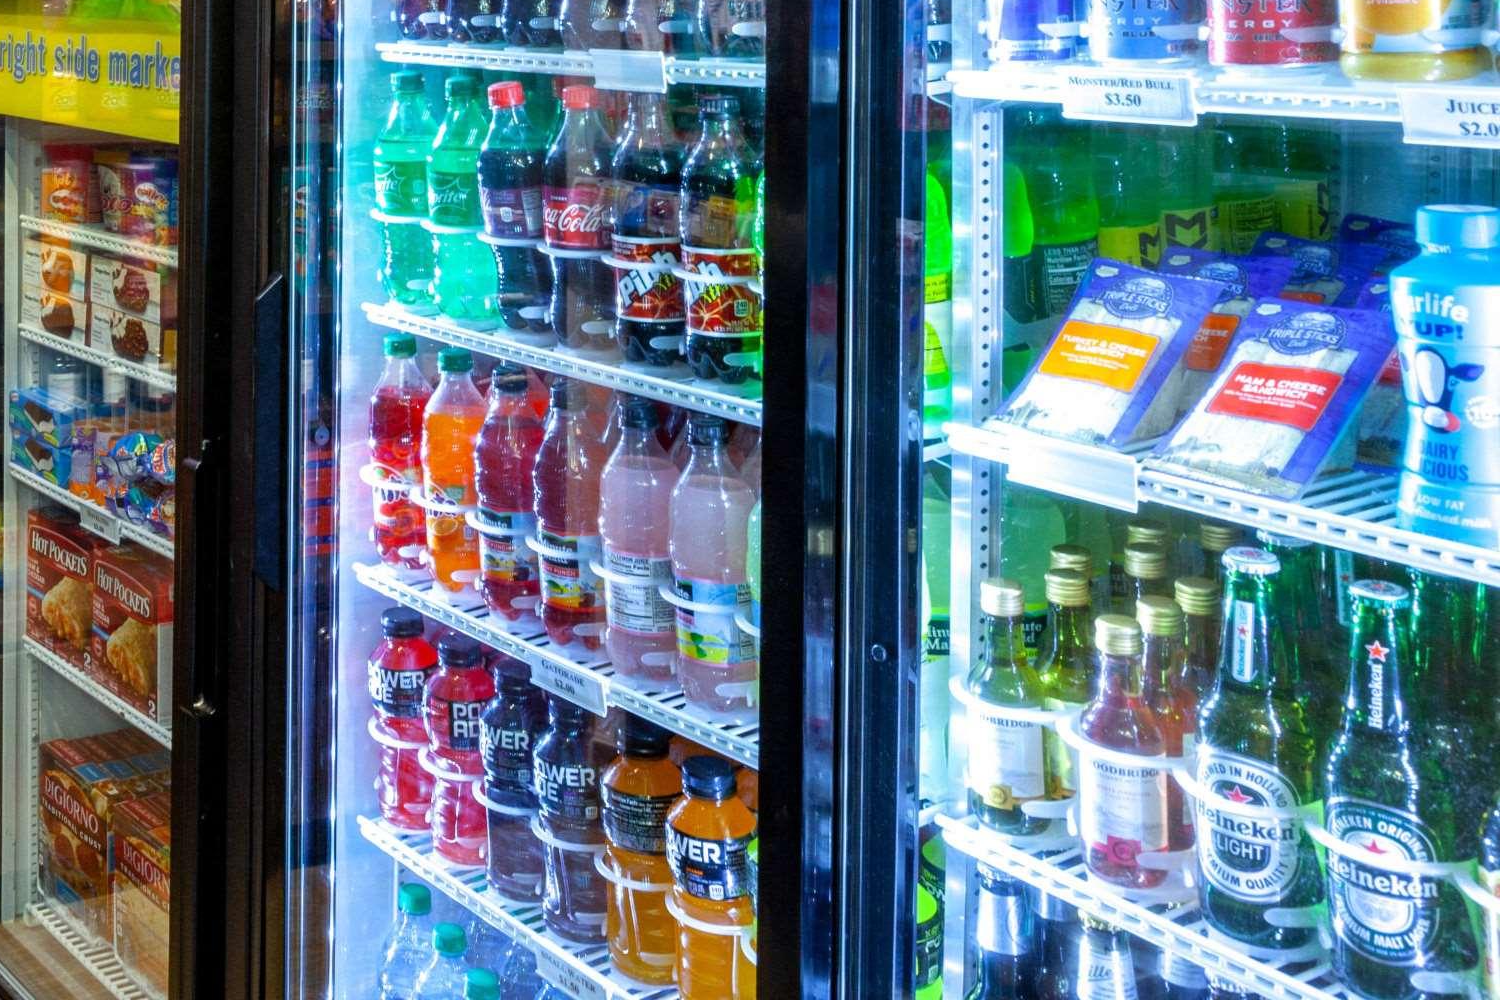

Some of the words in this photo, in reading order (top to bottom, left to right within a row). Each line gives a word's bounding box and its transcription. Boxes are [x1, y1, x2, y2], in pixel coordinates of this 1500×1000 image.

[1228, 18, 1293, 29] ERGY
[53, 34, 99, 82] side
[109, 41, 180, 92] marke
[1068, 75, 1142, 89] MONSTER/RED
[1145, 79, 1174, 91] BULL
[1104, 92, 1141, 107] $3.50
[1459, 121, 1499, 136] $2.0
[544, 204, 602, 232] ca-Cola
[1103, 291, 1133, 304] TRIPLE
[1136, 295, 1169, 313] STICKS
[1269, 329, 1304, 340] TRIPLE
[1306, 331, 1340, 345] STICKS
[1414, 321, 1464, 340] UP!
[1063, 334, 1097, 347] TURKEY
[1099, 338, 1108, 347] &
[1109, 341, 1147, 358] CHEESE
[1074, 343, 1126, 360] SANDWICH
[1235, 374, 1265, 387] HAM
[1266, 378, 1276, 387] &
[1278, 380, 1327, 396] CHEESE
[1242, 384, 1308, 401] SANDWICH
[32, 531, 48, 556] HOT
[49, 541, 88, 577] POCKETS
[97, 566, 114, 594] HOT
[114, 582, 150, 619] POCKETS
[84, 654, 91, 669] 2
[1367, 661, 1384, 730] Heineken
[148, 701, 156, 719] 2
[1092, 760, 1159, 778] OODBRIDGE
[1229, 766, 1242, 778] IN
[44, 775, 100, 835] DIGIORNO
[42, 798, 78, 837] TRADITIONAL
[80, 831, 102, 851] CRUST
[1215, 834, 1267, 861] LIGHT
[122, 841, 169, 890] DIGIORN
[1245, 860, 1290, 891] QUALITY
[1327, 851, 1439, 899] Heineken
[120, 862, 159, 902] TRADITIONAL
[1373, 933, 1405, 950] MALT
